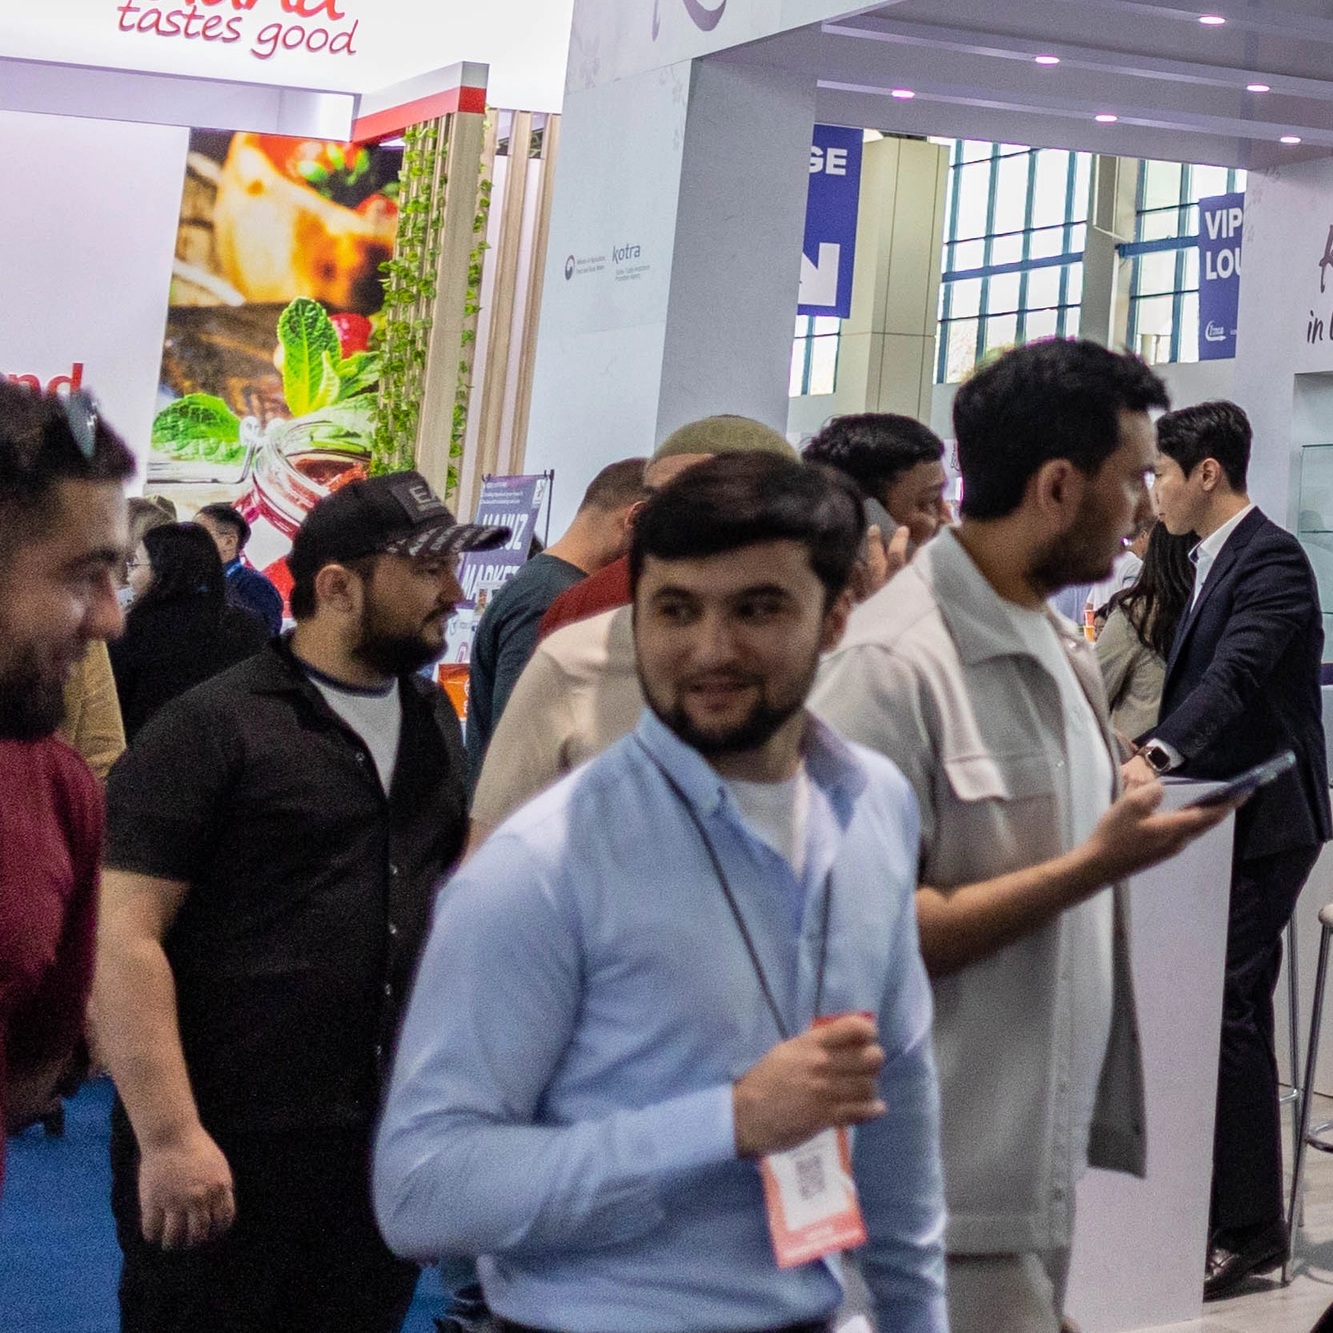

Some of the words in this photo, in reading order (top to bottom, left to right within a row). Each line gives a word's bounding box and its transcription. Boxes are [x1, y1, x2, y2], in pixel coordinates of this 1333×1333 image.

[250, 18, 358, 59] good
[1204, 207, 1242, 241] VIP
[612, 243, 641, 264] kotra
[1307, 309, 1323, 344] in
